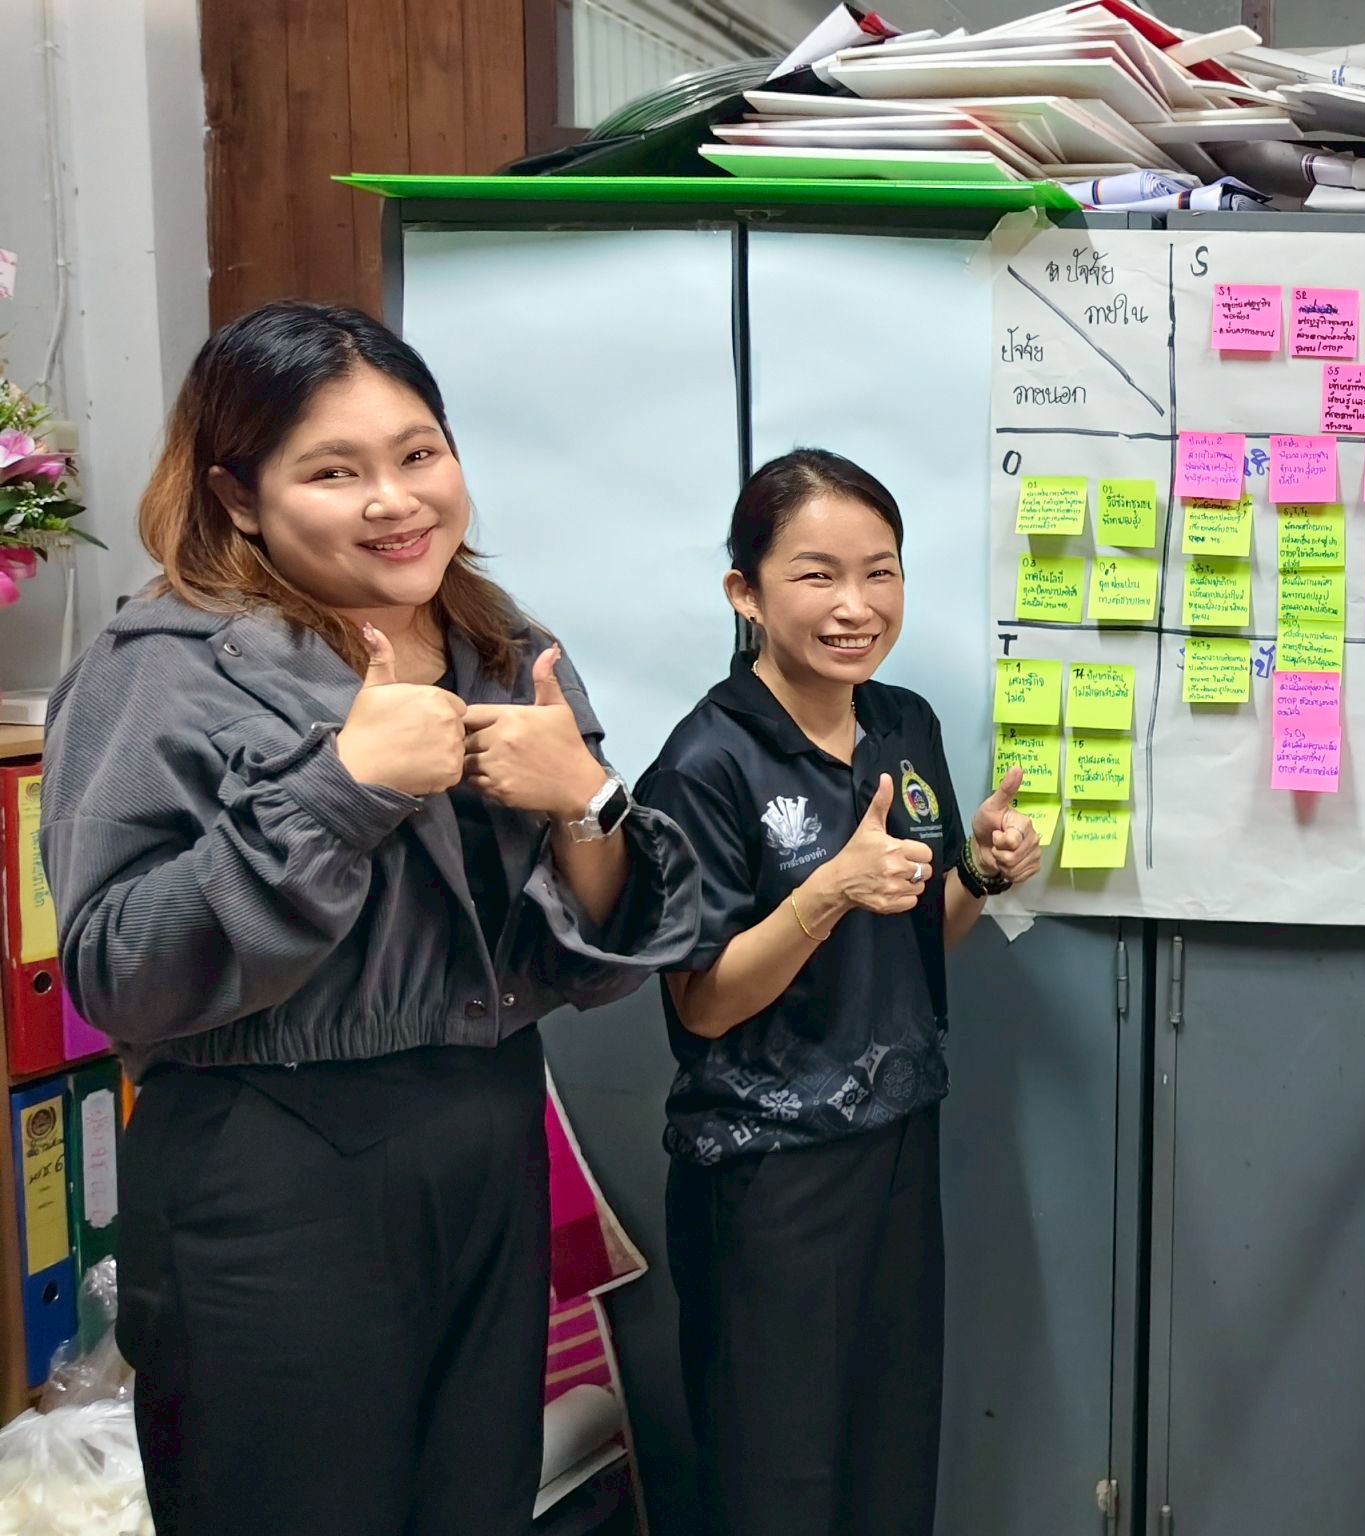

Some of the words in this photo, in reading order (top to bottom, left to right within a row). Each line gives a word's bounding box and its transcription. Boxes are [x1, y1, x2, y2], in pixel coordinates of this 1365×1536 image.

[1066, 247, 1114, 285] ปัจจัย
[1191, 246, 1208, 277] S
[1084, 293, 1148, 325] ภายใน
[1002, 326, 1043, 362] ปัจจัย
[1328, 366, 1340, 375] S5
[1013, 385, 1086, 405] ภายนอก
[998, 633, 1018, 656] T
